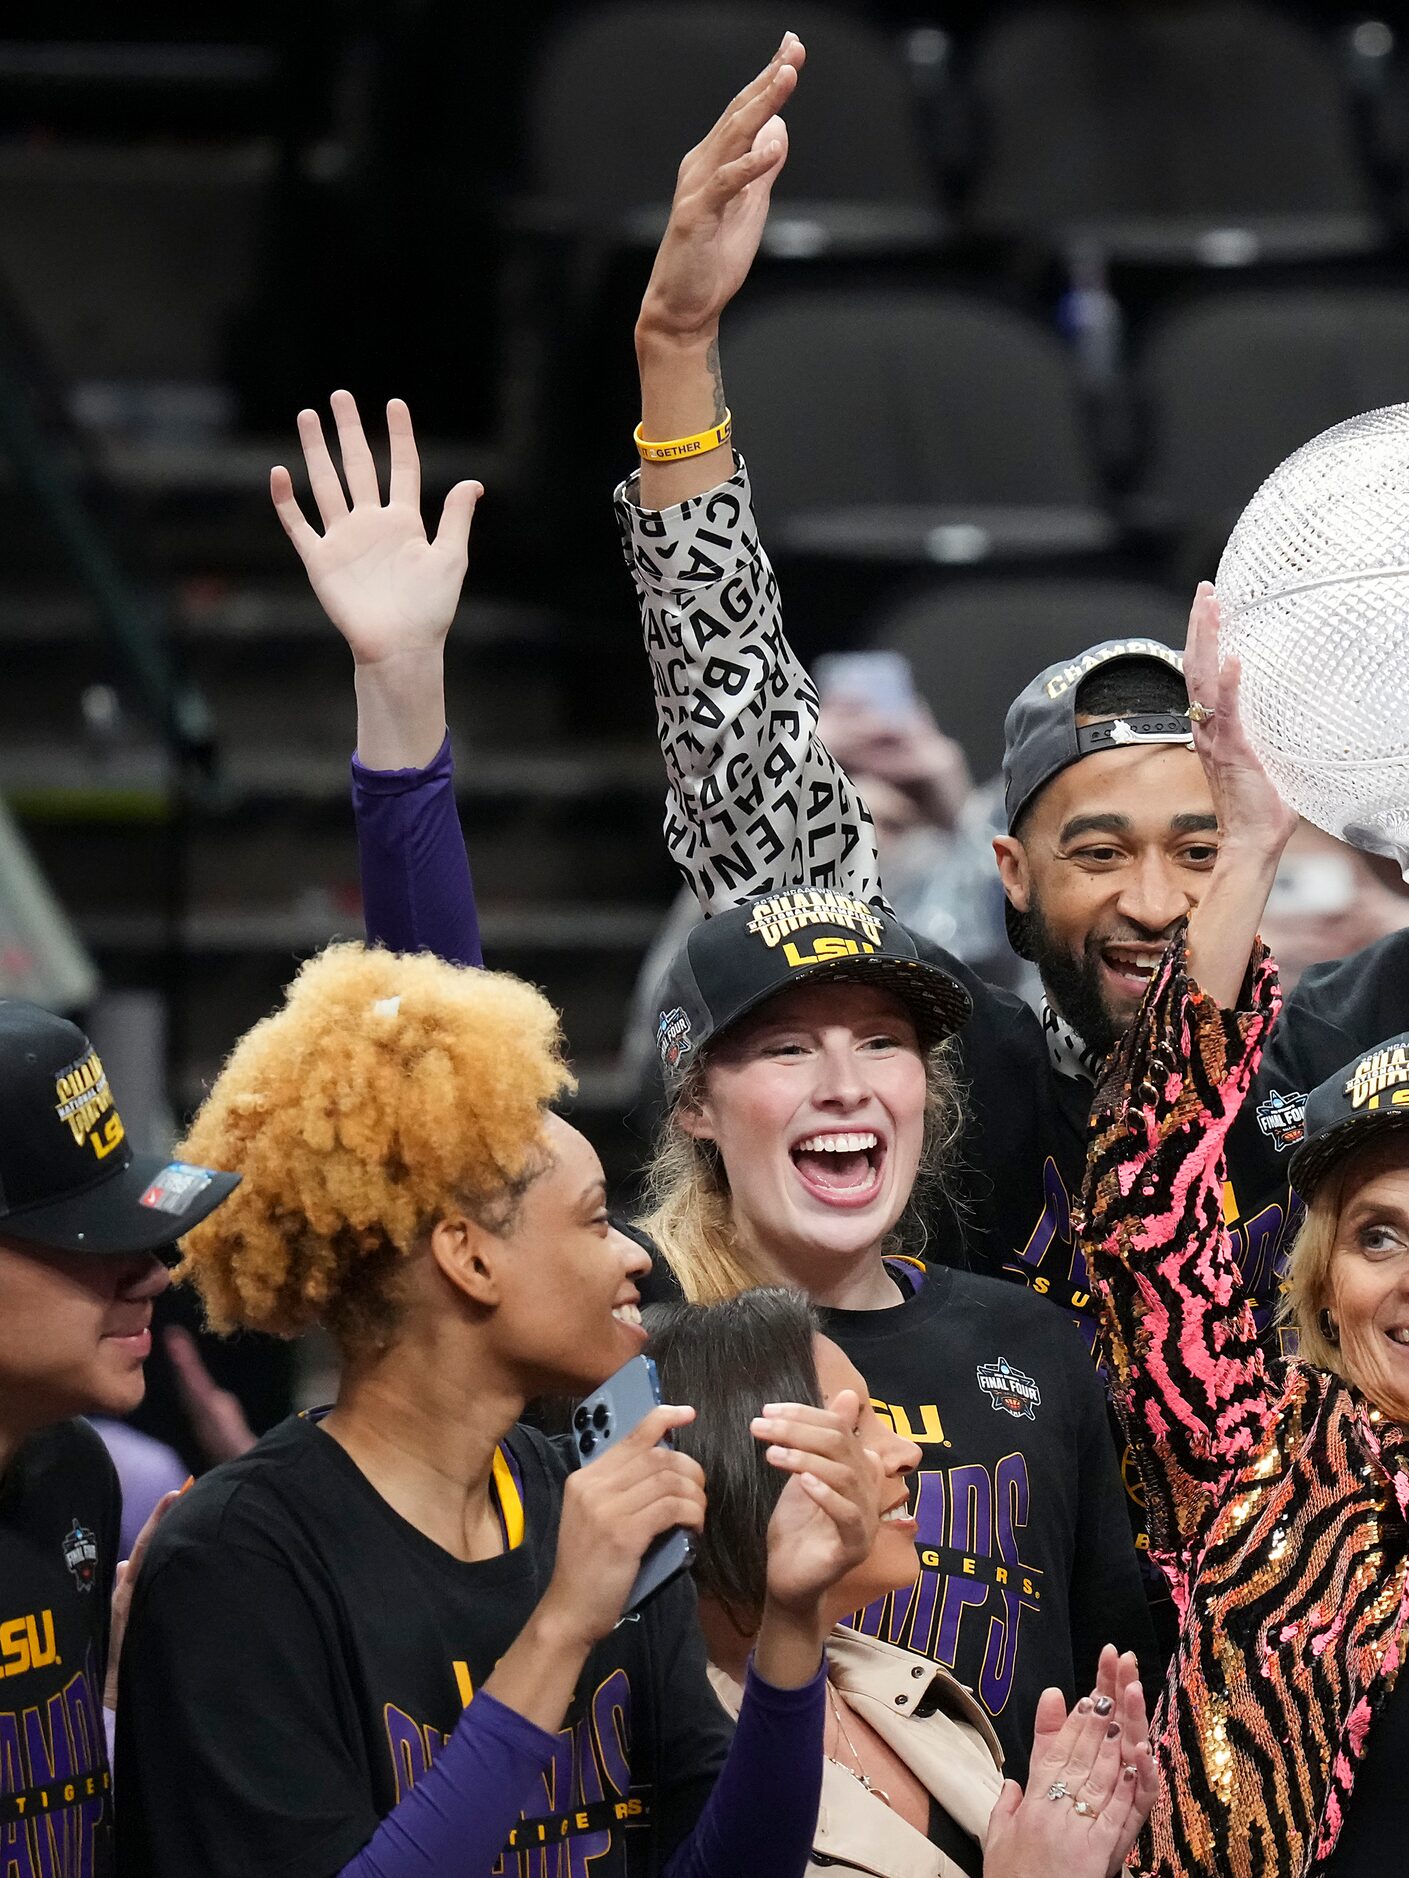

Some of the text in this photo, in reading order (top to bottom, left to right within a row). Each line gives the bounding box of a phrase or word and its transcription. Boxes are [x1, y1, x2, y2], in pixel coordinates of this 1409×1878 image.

[747, 905, 882, 930] NATIONAL CHAMPIONS
[752, 890, 882, 948] CHAMPS
[782, 937, 875, 967] LSU
[1345, 1063, 1403, 1088] NATIONAL
[1284, 1106, 1305, 1124] FOU
[979, 1376, 1039, 1401] FINAL FOUR
[0, 1609, 57, 1678] SU
